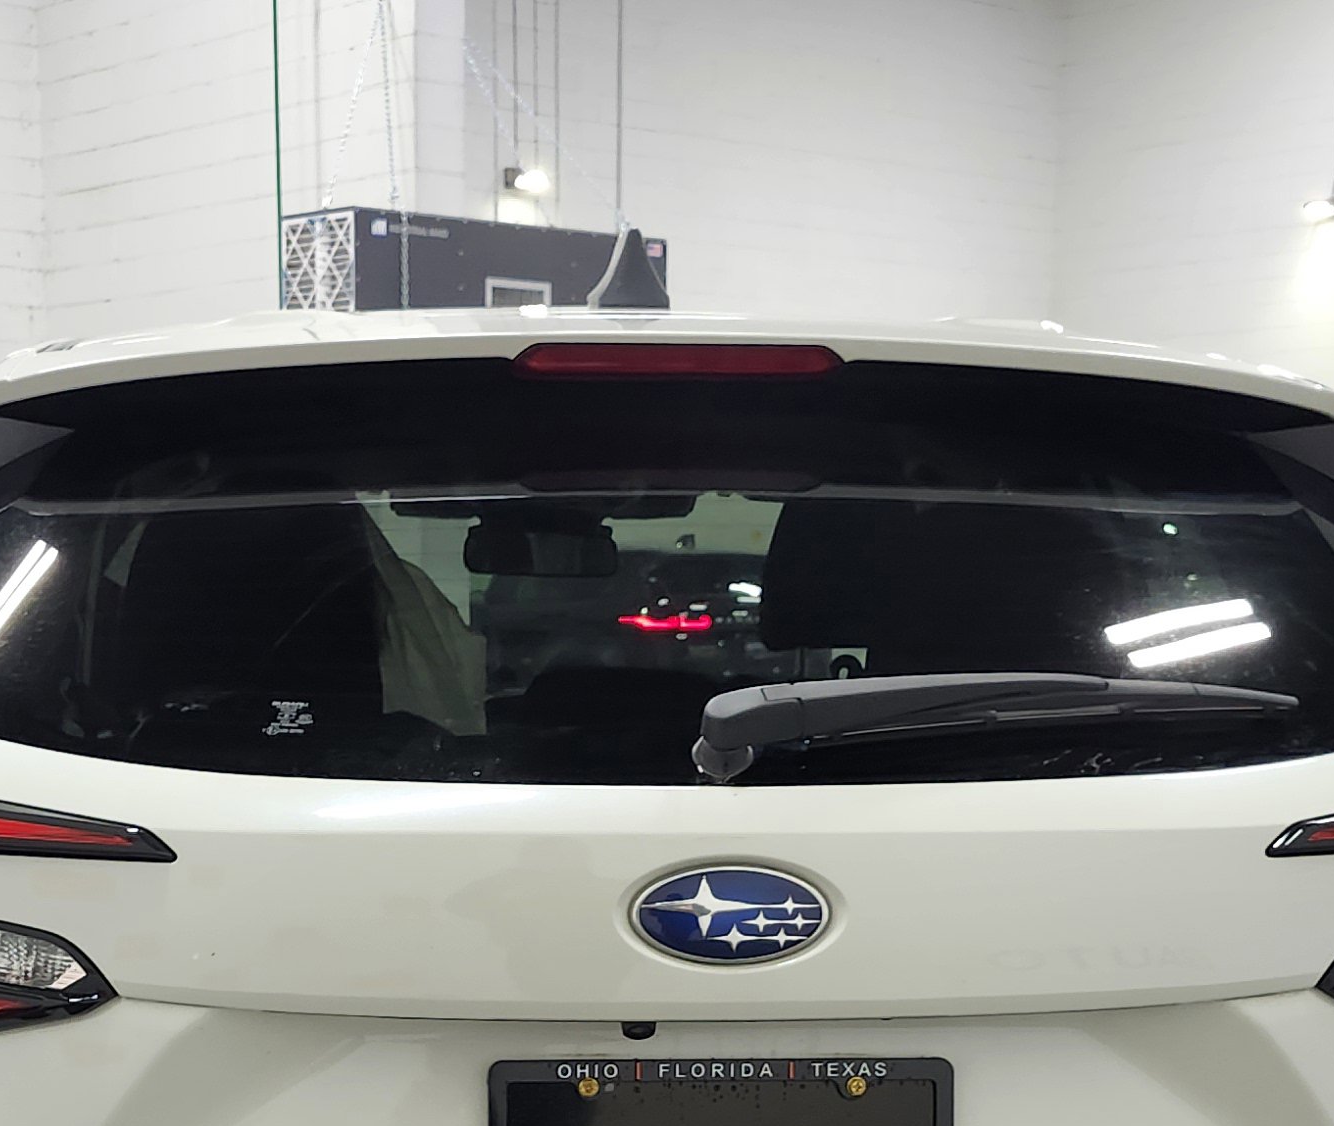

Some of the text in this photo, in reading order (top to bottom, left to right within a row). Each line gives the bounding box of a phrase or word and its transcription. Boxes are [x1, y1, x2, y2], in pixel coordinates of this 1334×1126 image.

[556, 1061, 888, 1079] OHIO FLORIDA TEXAS
